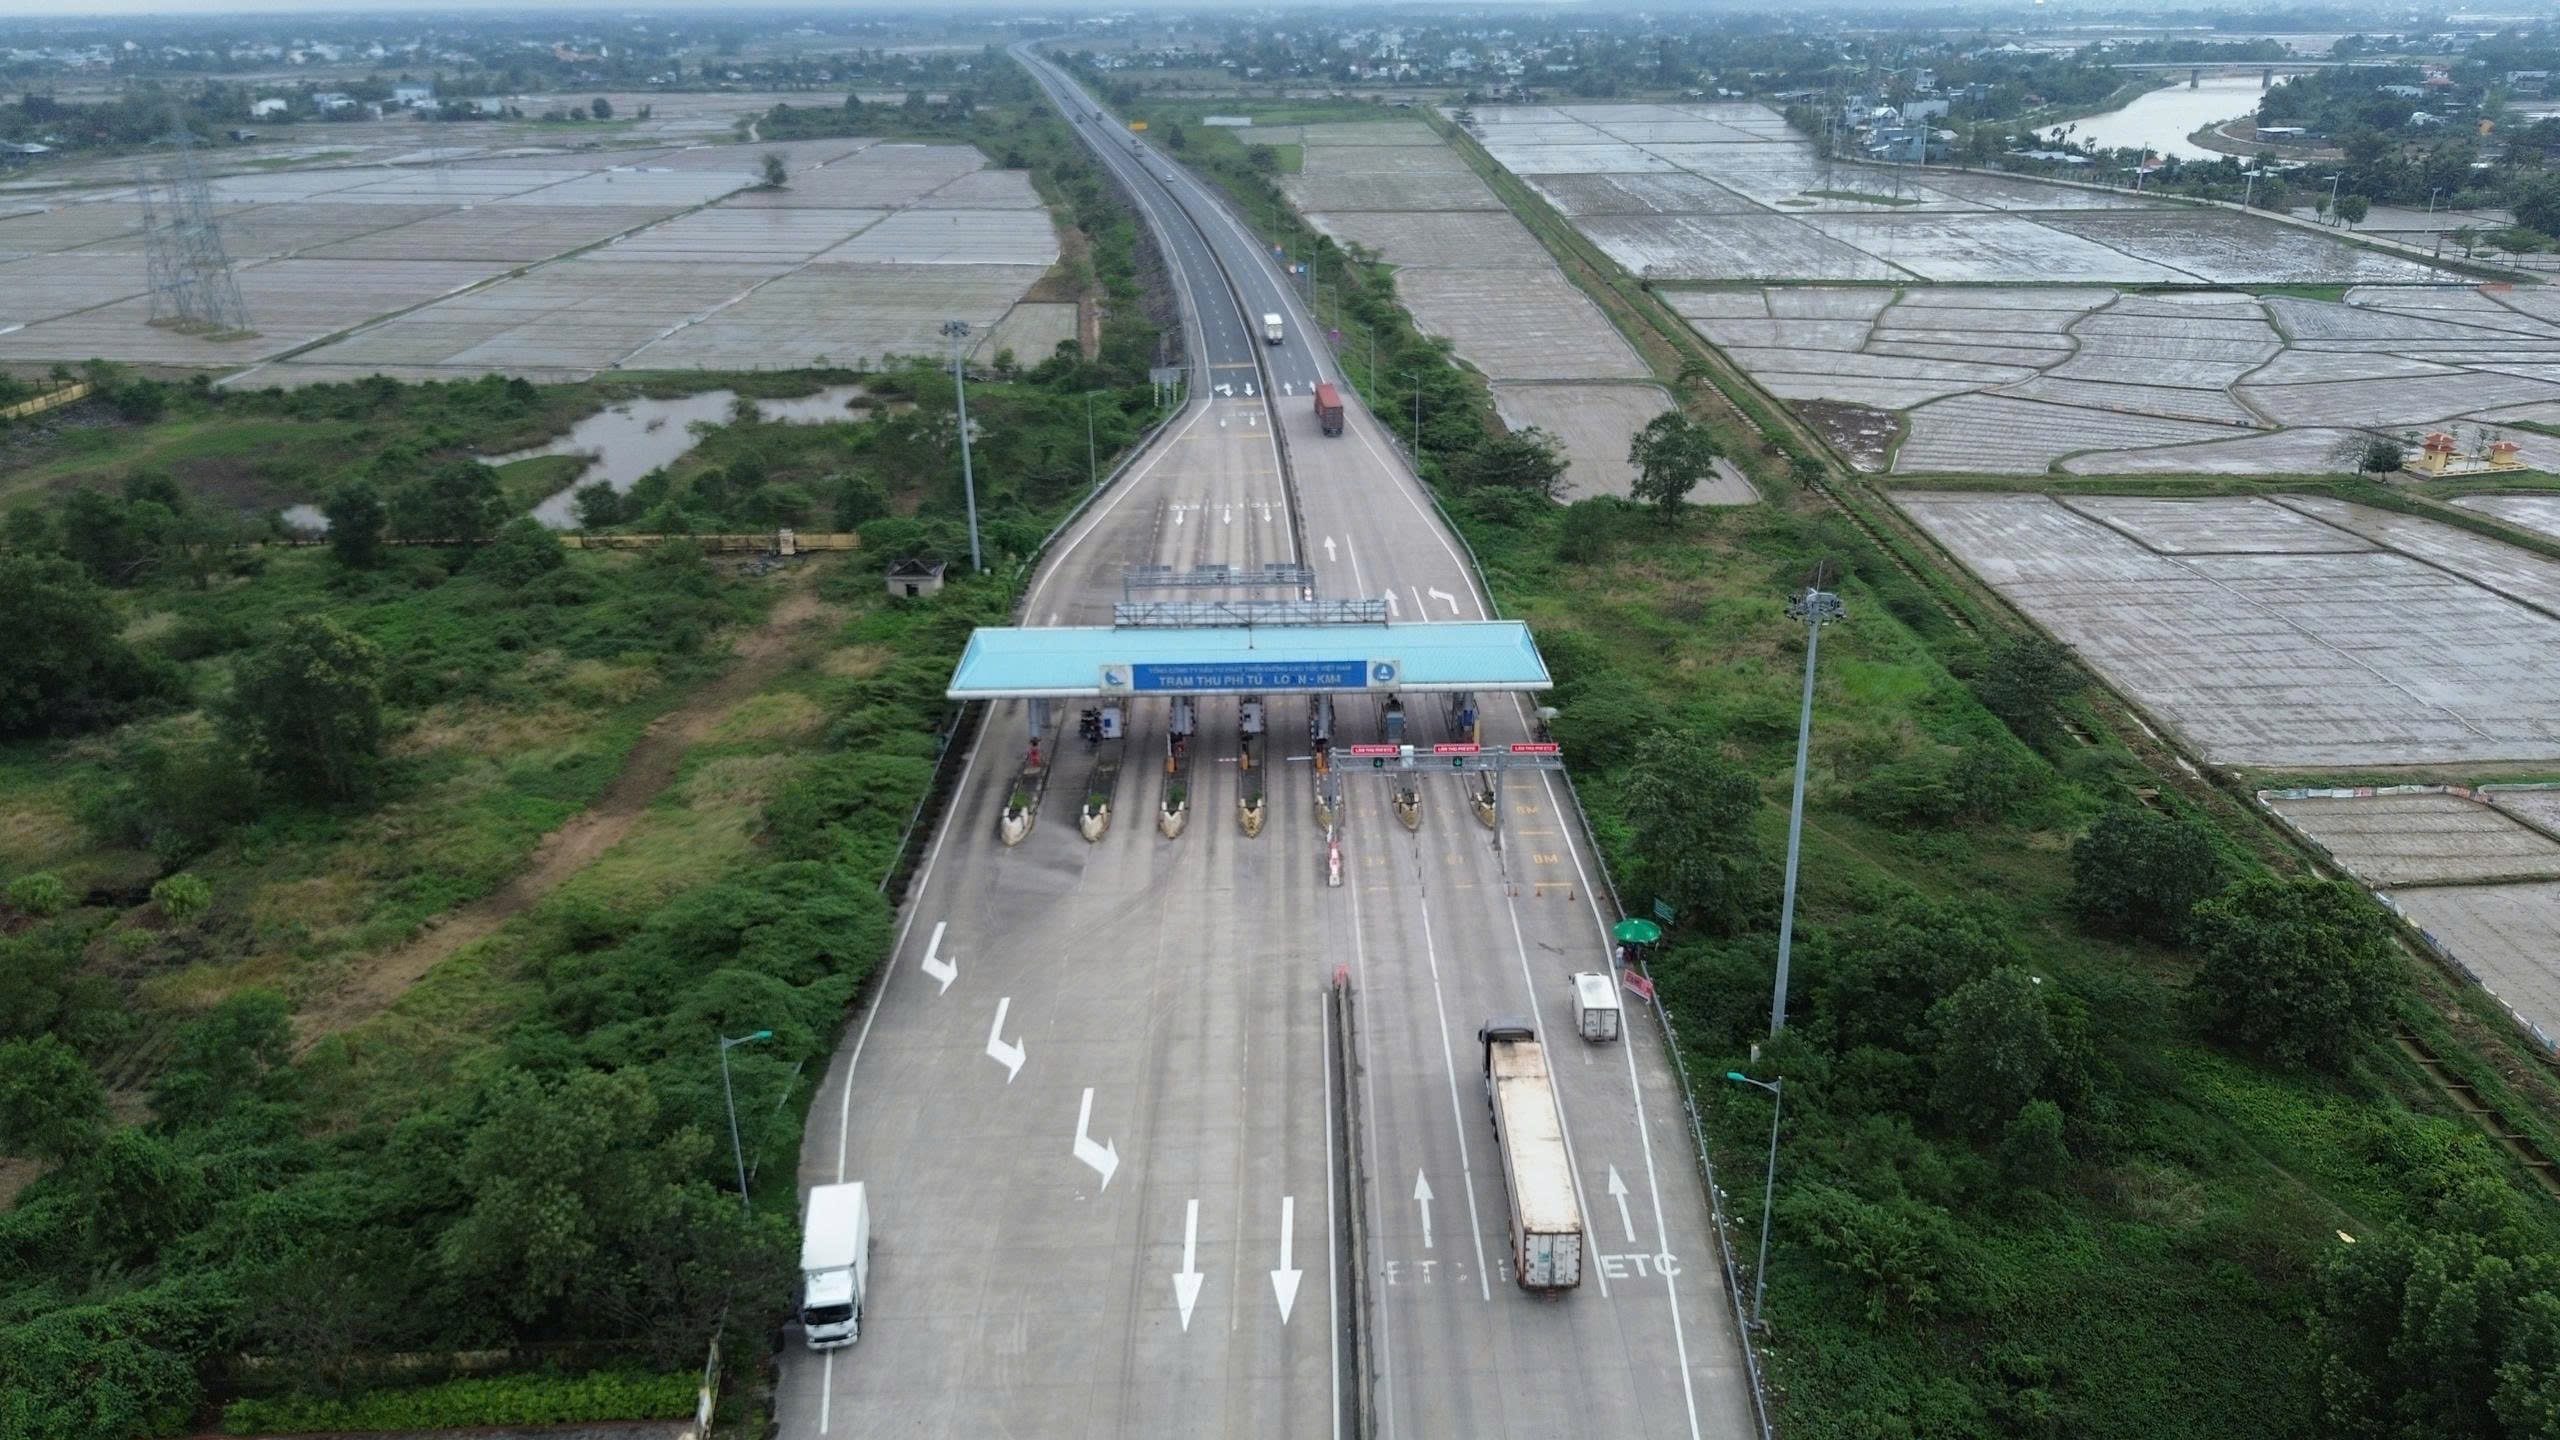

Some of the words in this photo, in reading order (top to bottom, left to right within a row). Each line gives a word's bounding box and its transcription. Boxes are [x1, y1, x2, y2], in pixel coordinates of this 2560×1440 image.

[1159, 676, 1194, 688] TRẠM
[1196, 676, 1221, 686] THU
[1224, 673, 1244, 686] PHÍ
[1600, 1254, 1681, 1279] ETC
